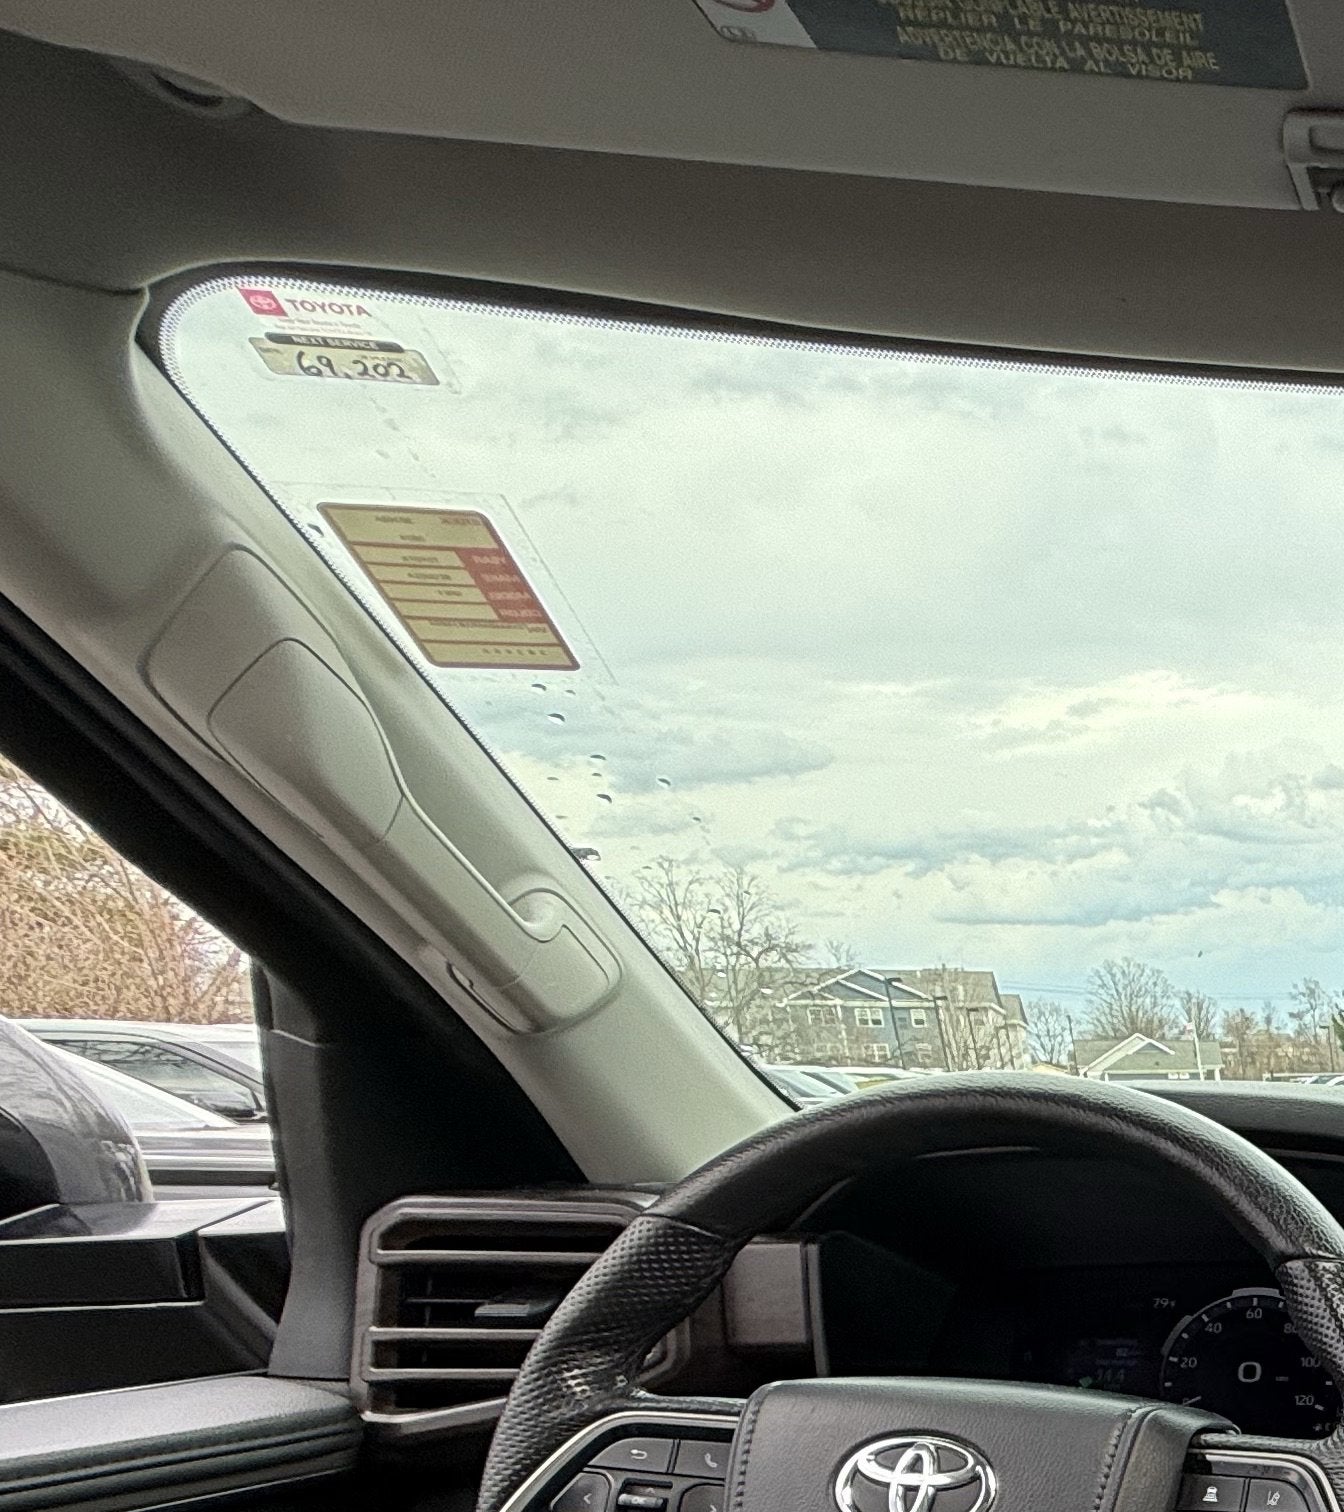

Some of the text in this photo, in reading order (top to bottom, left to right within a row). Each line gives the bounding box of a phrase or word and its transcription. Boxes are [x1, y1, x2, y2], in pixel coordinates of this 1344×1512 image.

[1069, 2, 1202, 32] AVERTISSEMENT
[1012, 16, 1041, 32] LE
[1058, 20, 1200, 46] PARESOLEIL
[1019, 35, 1058, 55] CON
[1062, 40, 1088, 58] LA
[1089, 41, 1150, 64] BOLSA
[1152, 47, 1177, 66] DE
[1181, 49, 1220, 71] AIRE
[939, 47, 1194, 81] DE VUELTA AL VISOR
[284, 298, 373, 318] TOYOTA
[290, 335, 380, 351] NEXT SERVICE
[1246, 1308, 1263, 1319] 60
[1204, 1323, 1223, 1334] 40
[1180, 1357, 1198, 1368] 20
[1300, 1357, 1321, 1368] 100
[1238, 1361, 1262, 1383] 0
[1294, 1395, 1315, 1406] 120
